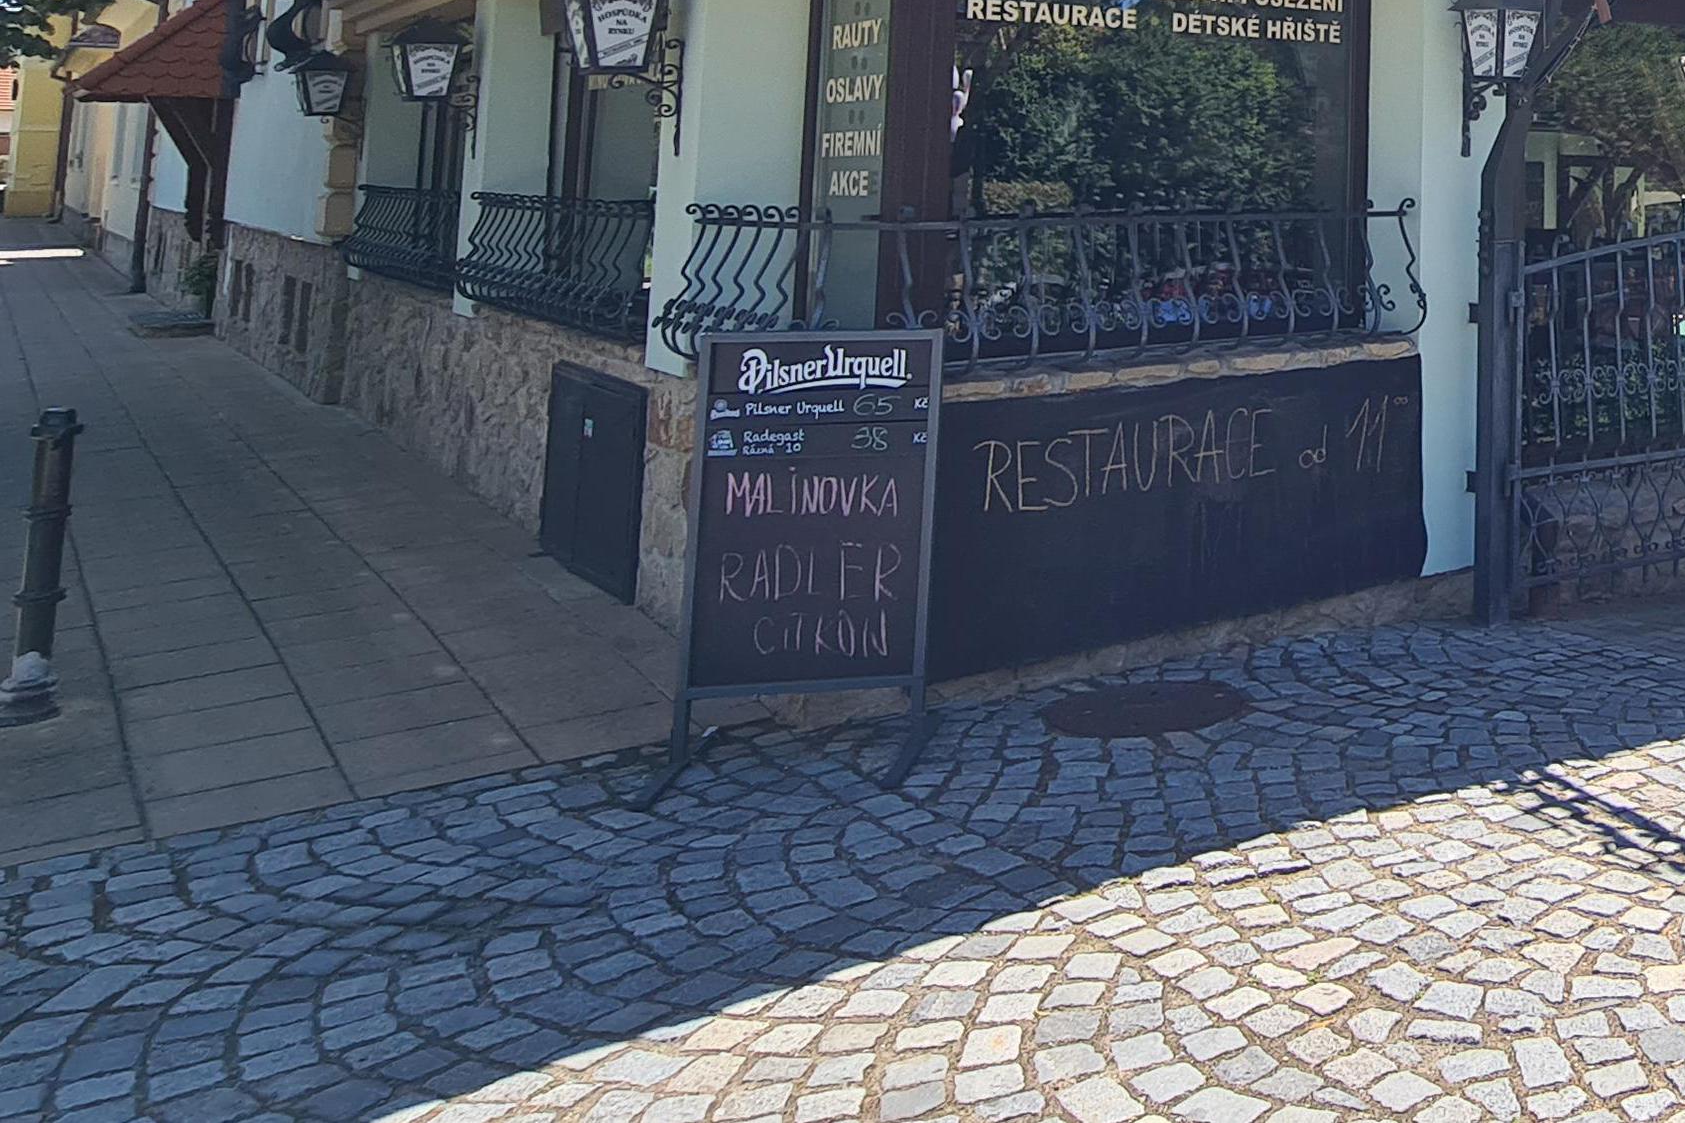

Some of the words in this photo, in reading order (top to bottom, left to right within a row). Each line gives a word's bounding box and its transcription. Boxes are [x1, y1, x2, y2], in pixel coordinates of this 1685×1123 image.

[832, 18, 882, 50] RAUTY
[1266, 16, 1341, 44] HŘIŠTĚ
[826, 75, 884, 103] OSLAVY
[821, 124, 882, 158] FIREMNÍ
[829, 171, 869, 196] AKCE
[738, 348, 827, 394] Pilsner
[824, 345, 908, 390] Urquell
[745, 402, 792, 416] Pilsner
[796, 399, 845, 420] Urquell
[853, 394, 901, 416] 65
[743, 428, 805, 446] Radegast
[851, 426, 888, 451] 38
[786, 441, 802, 453] 10
[973, 408, 1276, 512] RESTAURACE
[1299, 425, 1328, 469] od
